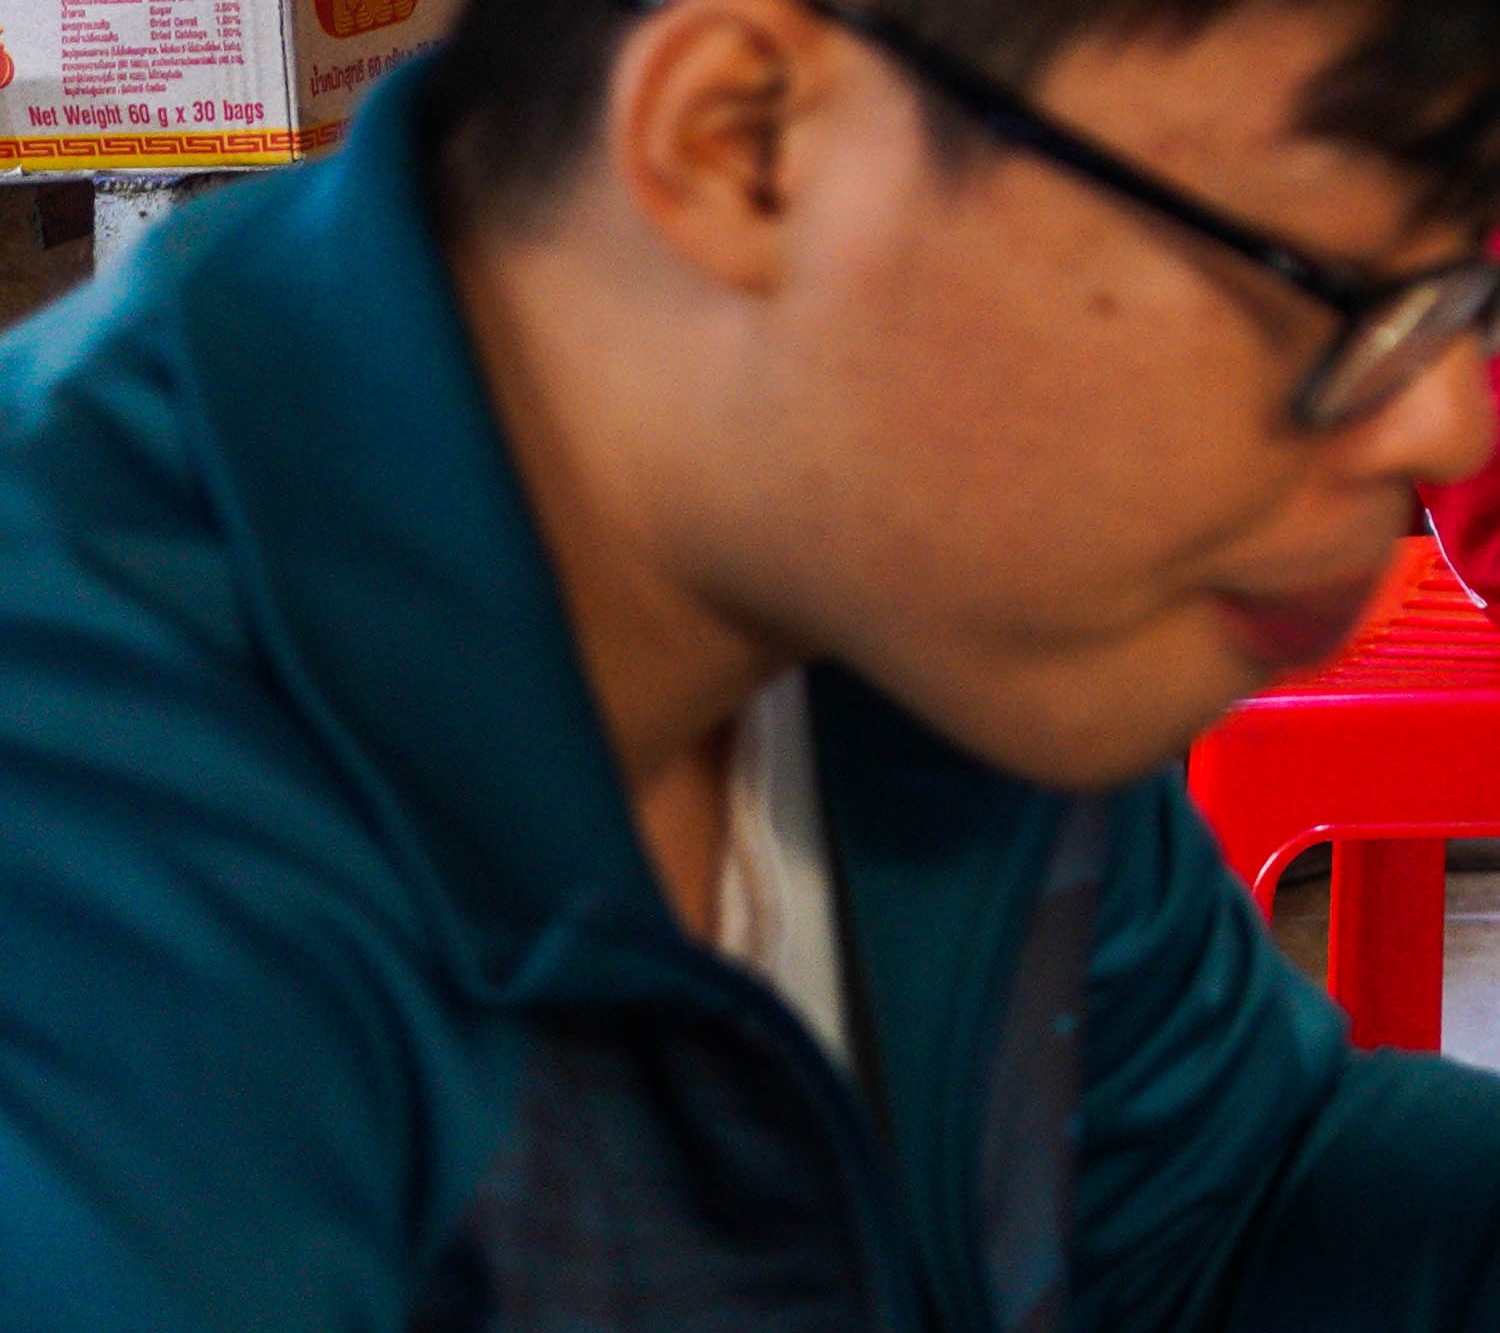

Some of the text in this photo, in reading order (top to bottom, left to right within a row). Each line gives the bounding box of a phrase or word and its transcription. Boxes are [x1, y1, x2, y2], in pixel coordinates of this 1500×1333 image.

[28, 99, 265, 129] Net Weight 60 g x 30 bags
